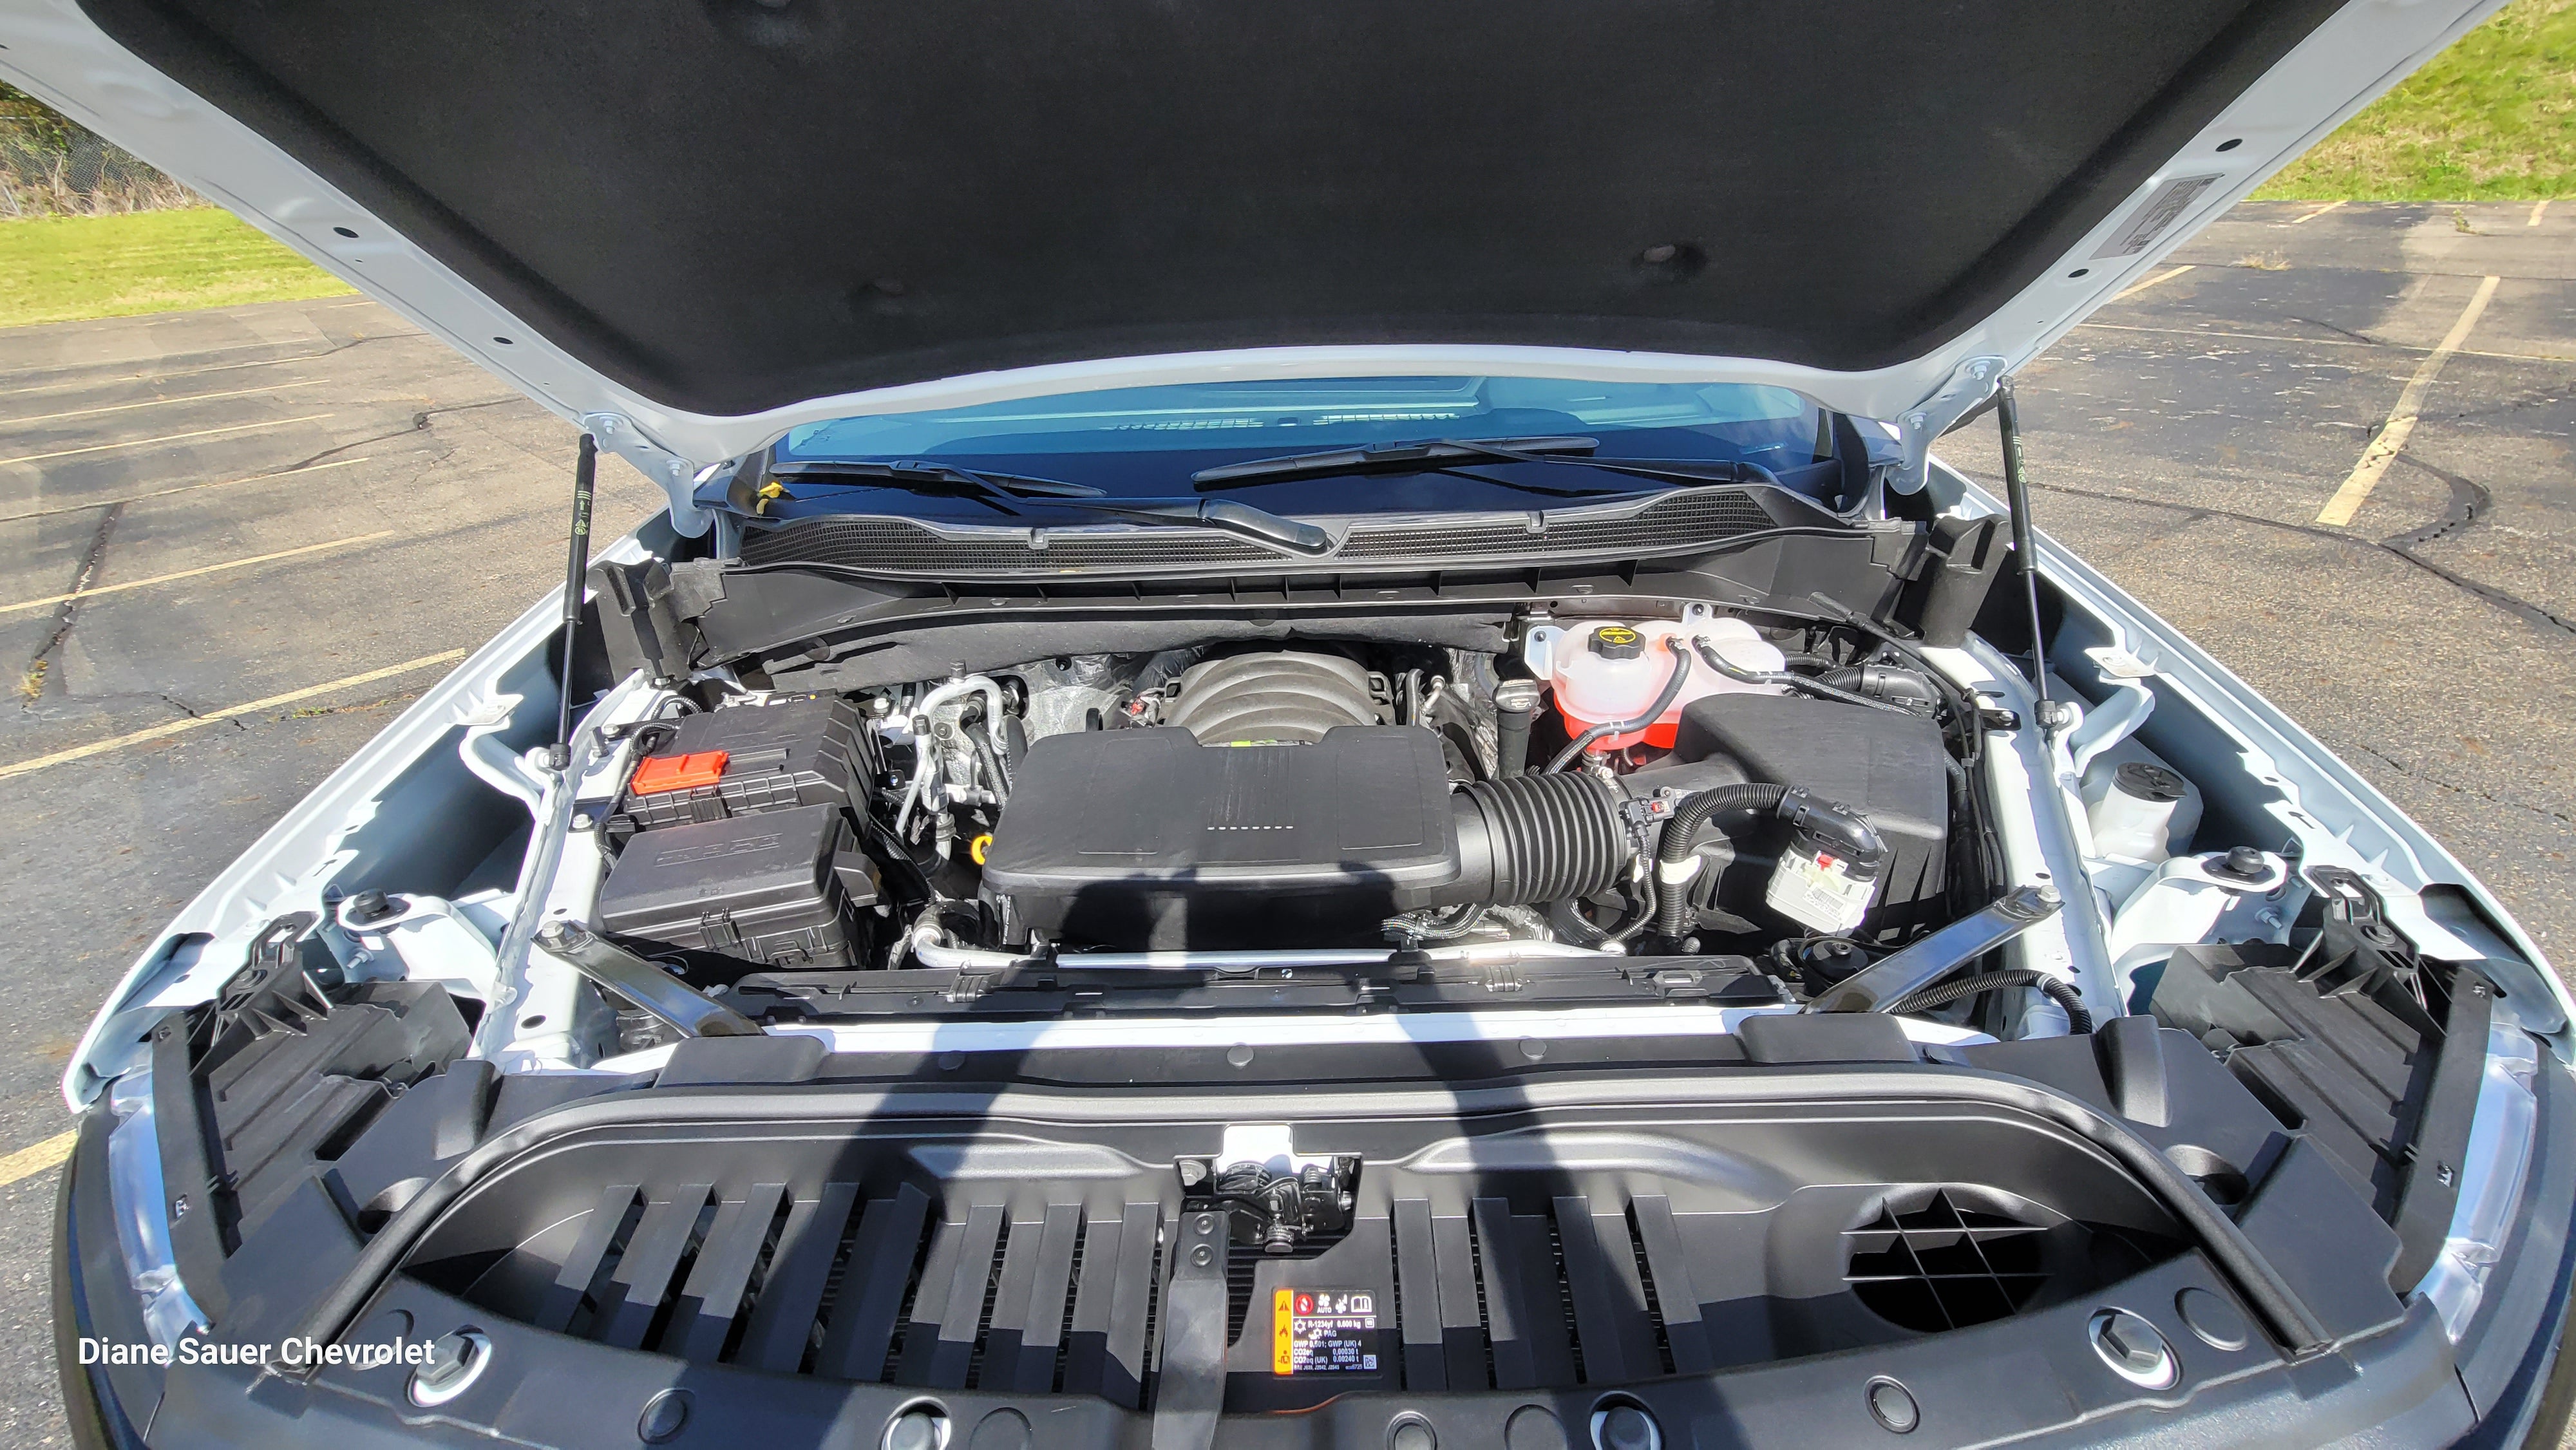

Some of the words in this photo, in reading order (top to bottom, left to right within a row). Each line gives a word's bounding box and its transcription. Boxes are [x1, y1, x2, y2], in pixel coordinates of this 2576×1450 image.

[1307, 1320, 1333, 1329] R-1234yf
[1354, 1320, 1361, 1329] kg
[1344, 1340, 1357, 1348] (UK)
[1294, 1356, 1313, 1364] CO2eq
[1315, 1356, 1328, 1364] (UK)
